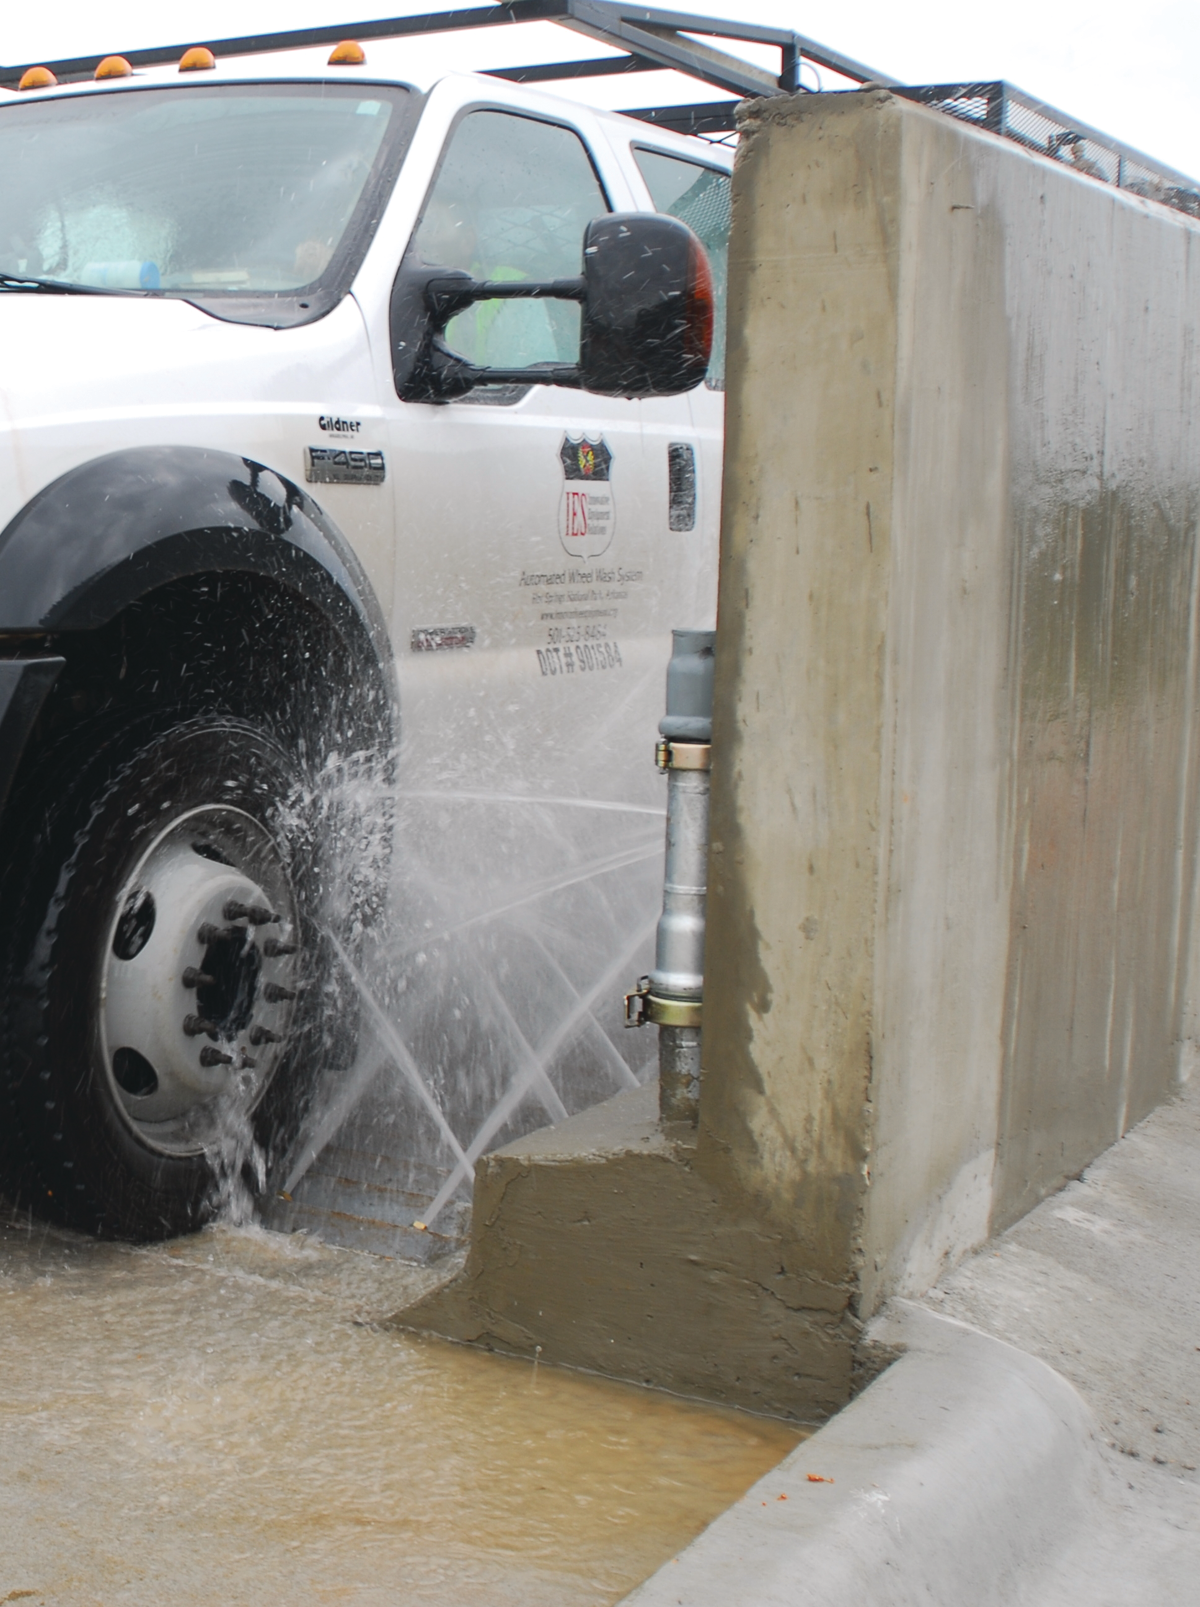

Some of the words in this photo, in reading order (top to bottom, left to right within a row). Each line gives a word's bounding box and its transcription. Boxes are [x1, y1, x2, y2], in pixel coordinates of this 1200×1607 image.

[318, 415, 361, 432] Gildner
[565, 491, 588, 536] IES
[519, 569, 566, 587] Automated
[568, 569, 593, 584] Wheel
[595, 567, 616, 583] Wash
[617, 566, 643, 586] System
[575, 641, 623, 673] 901584
